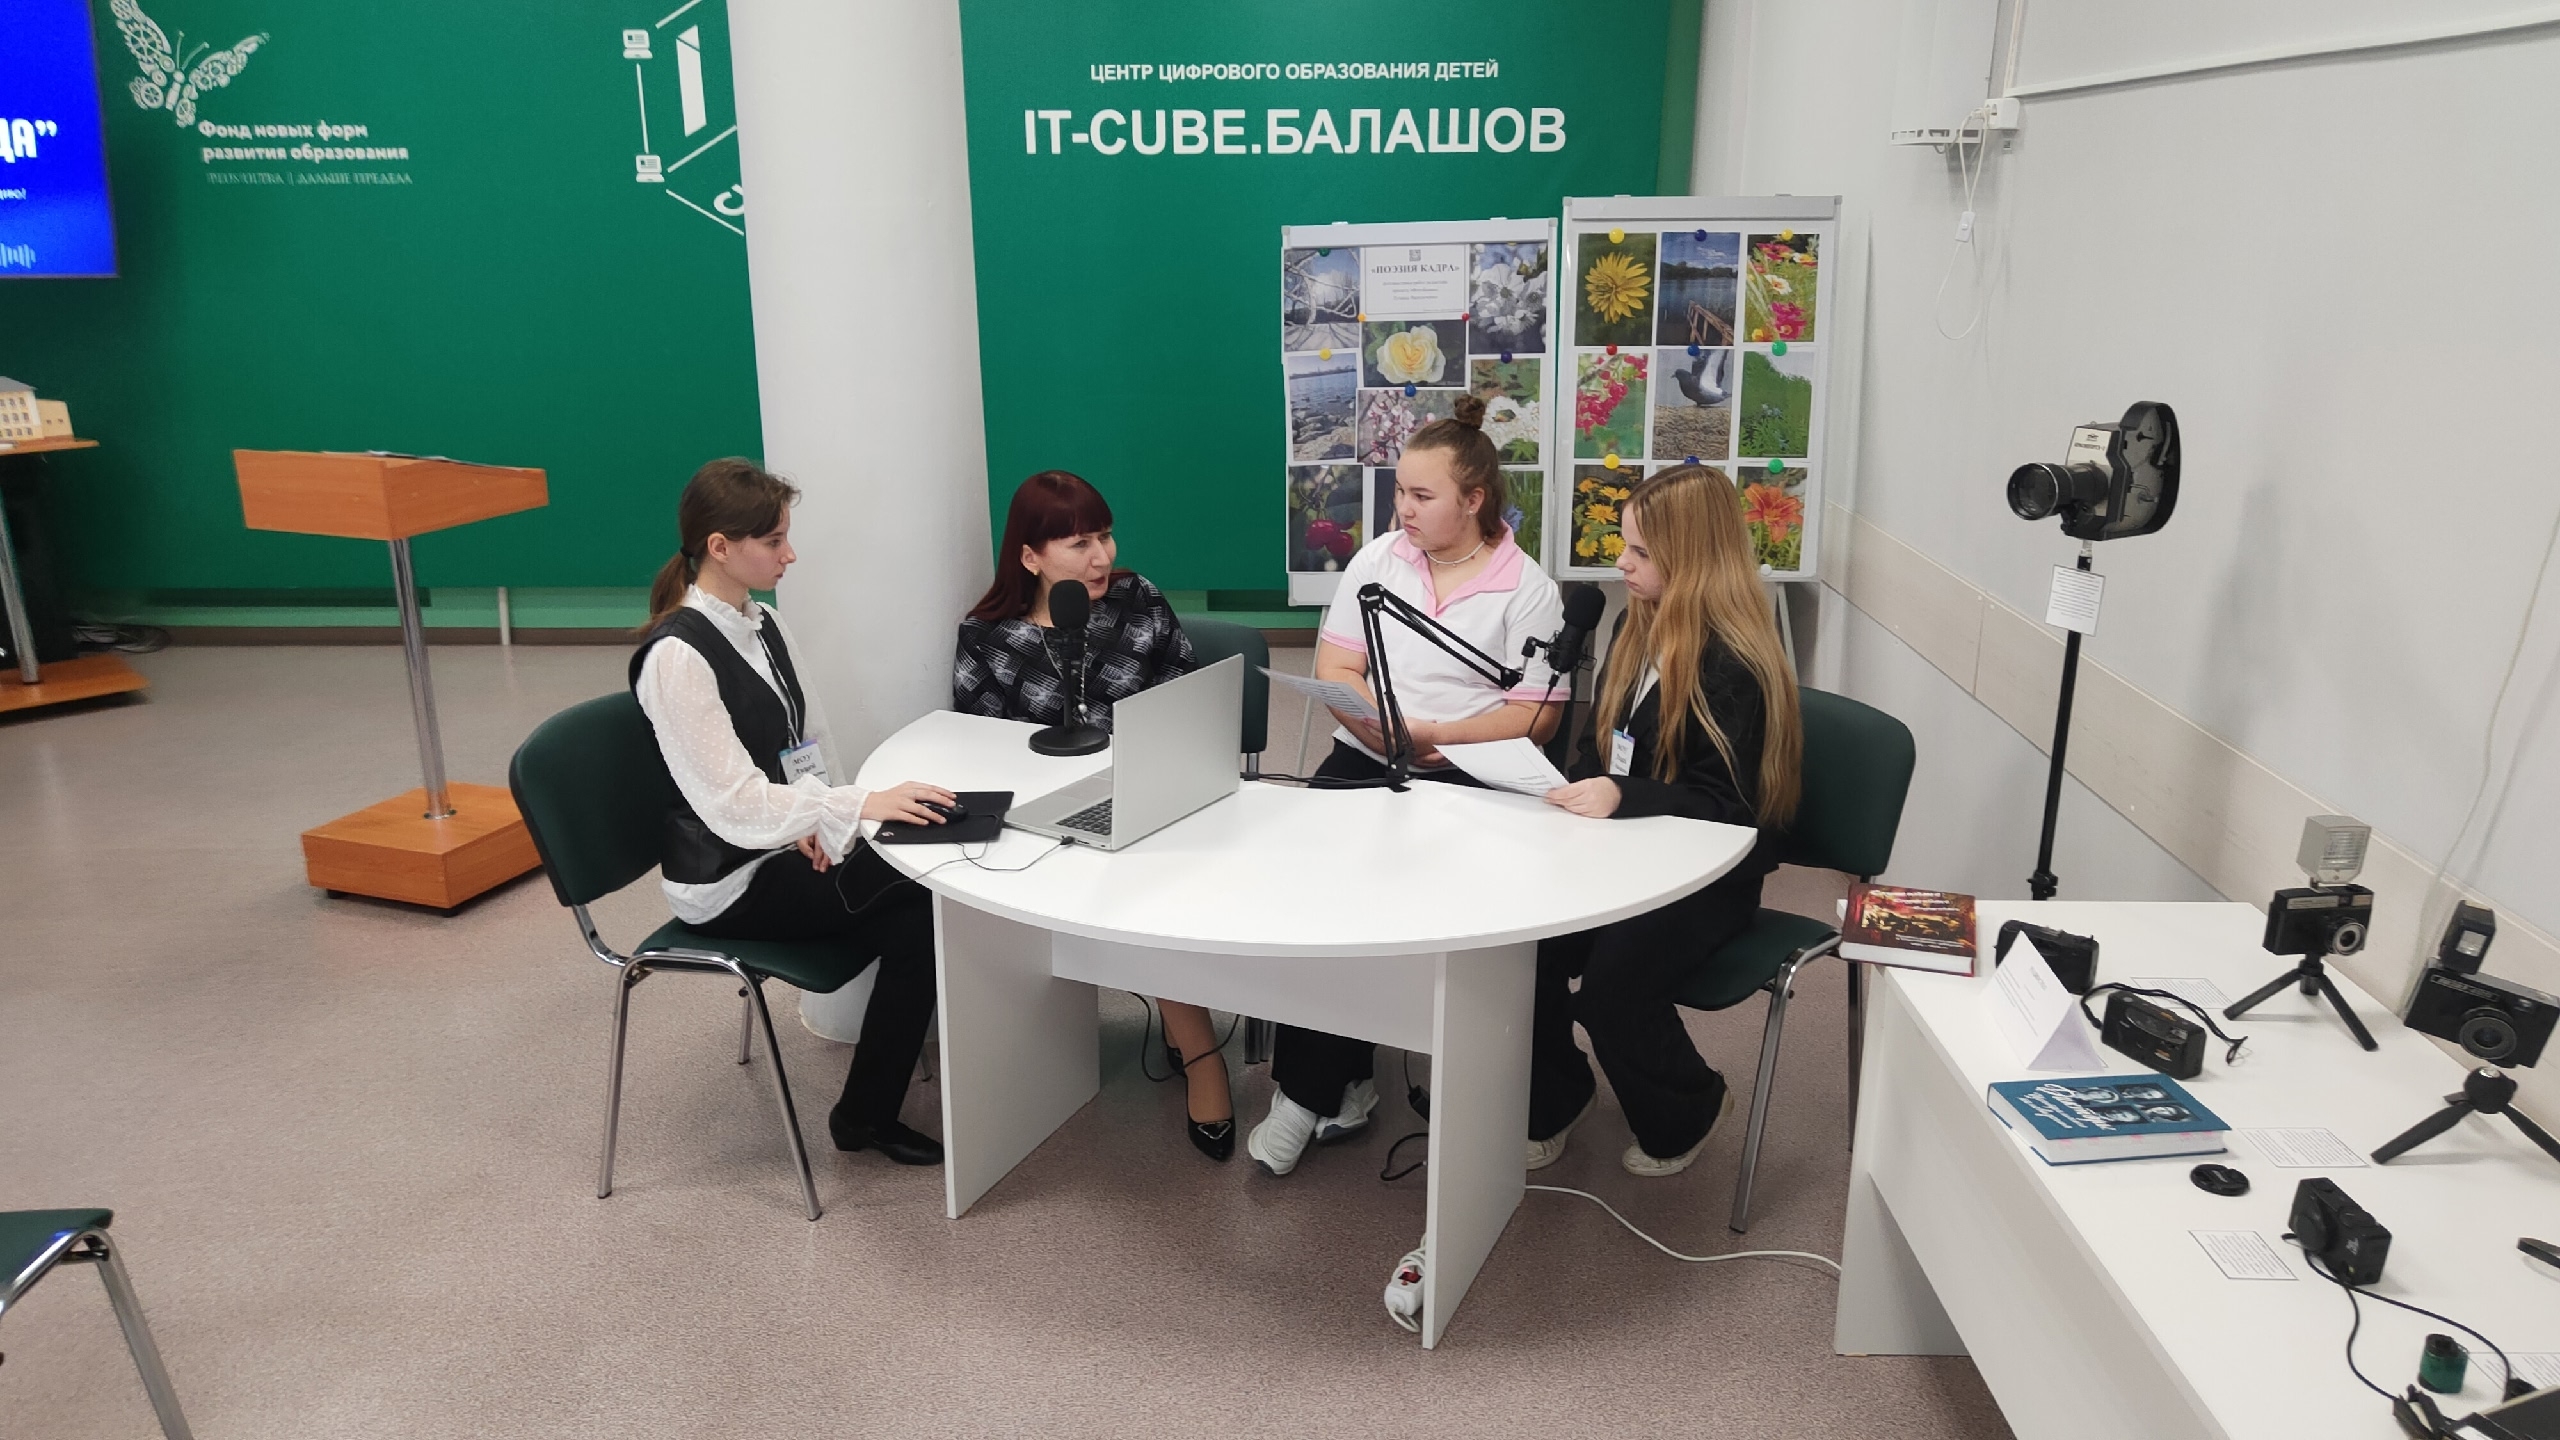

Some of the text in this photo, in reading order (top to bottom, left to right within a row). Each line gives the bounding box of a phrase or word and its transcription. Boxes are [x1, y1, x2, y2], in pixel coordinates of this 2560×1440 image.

[1090, 58, 1499, 84] ЦЕНТР ЦИФРОВОГО ОБРАЗОВАНИЯ ДЕТЕЙ
[198, 119, 368, 141] Фонд новых форм
[1024, 107, 1567, 155] IT-CUBE.БАЛАШОВ
[203, 143, 409, 164] развития образования
